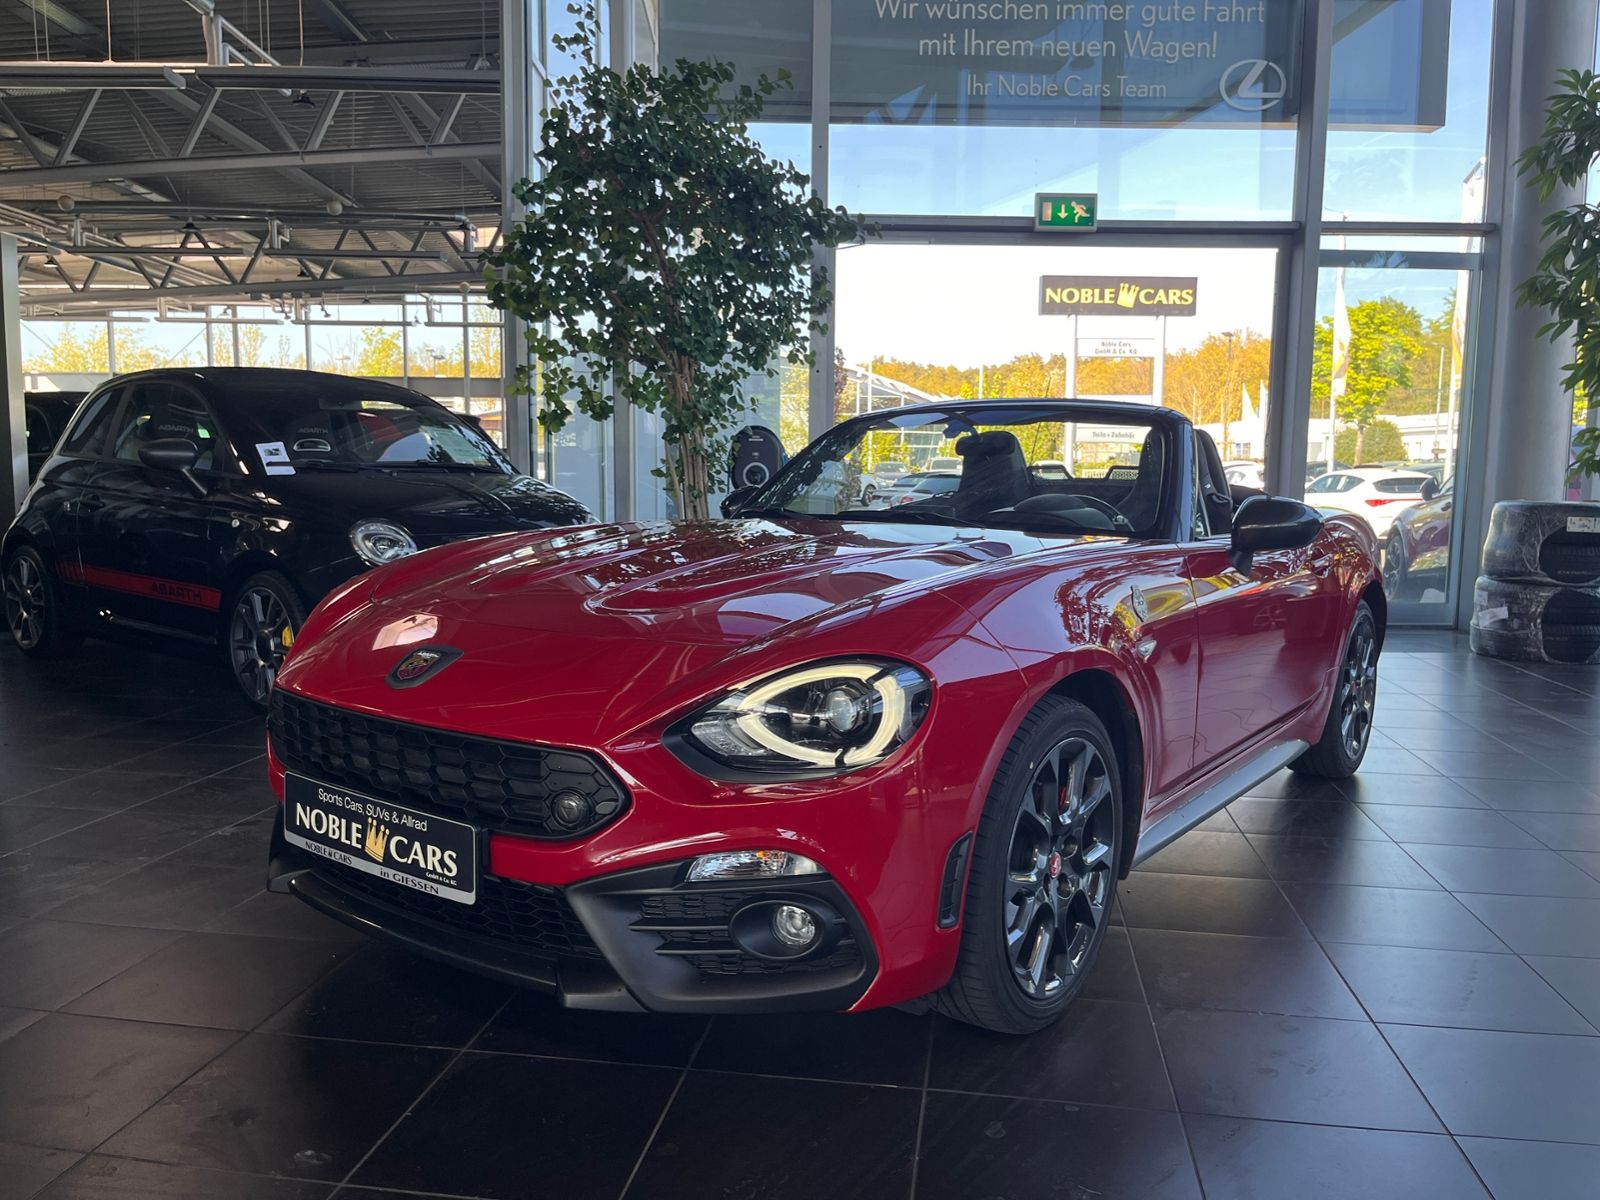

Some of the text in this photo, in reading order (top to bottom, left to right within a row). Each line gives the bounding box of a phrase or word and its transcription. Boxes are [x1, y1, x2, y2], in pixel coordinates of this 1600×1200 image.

[875, 0, 1265, 28] Wir wünschen immer gute Fahrt
[919, 29, 1217, 64] mit Ihrem neuen Wagen!
[967, 74, 1167, 97] Ihr Noble Cars Team
[1045, 287, 1194, 305] NOBLE CARS
[151, 581, 203, 602] ABARTH
[318, 788, 343, 807] Sports
[366, 803, 390, 822] SUVs
[391, 811, 400, 824] &
[401, 816, 428, 832] Allrad
[296, 802, 458, 878] NOBLE CARS
[305, 840, 353, 866] NOBLE CARS
[380, 868, 440, 896] in GIESSEN
